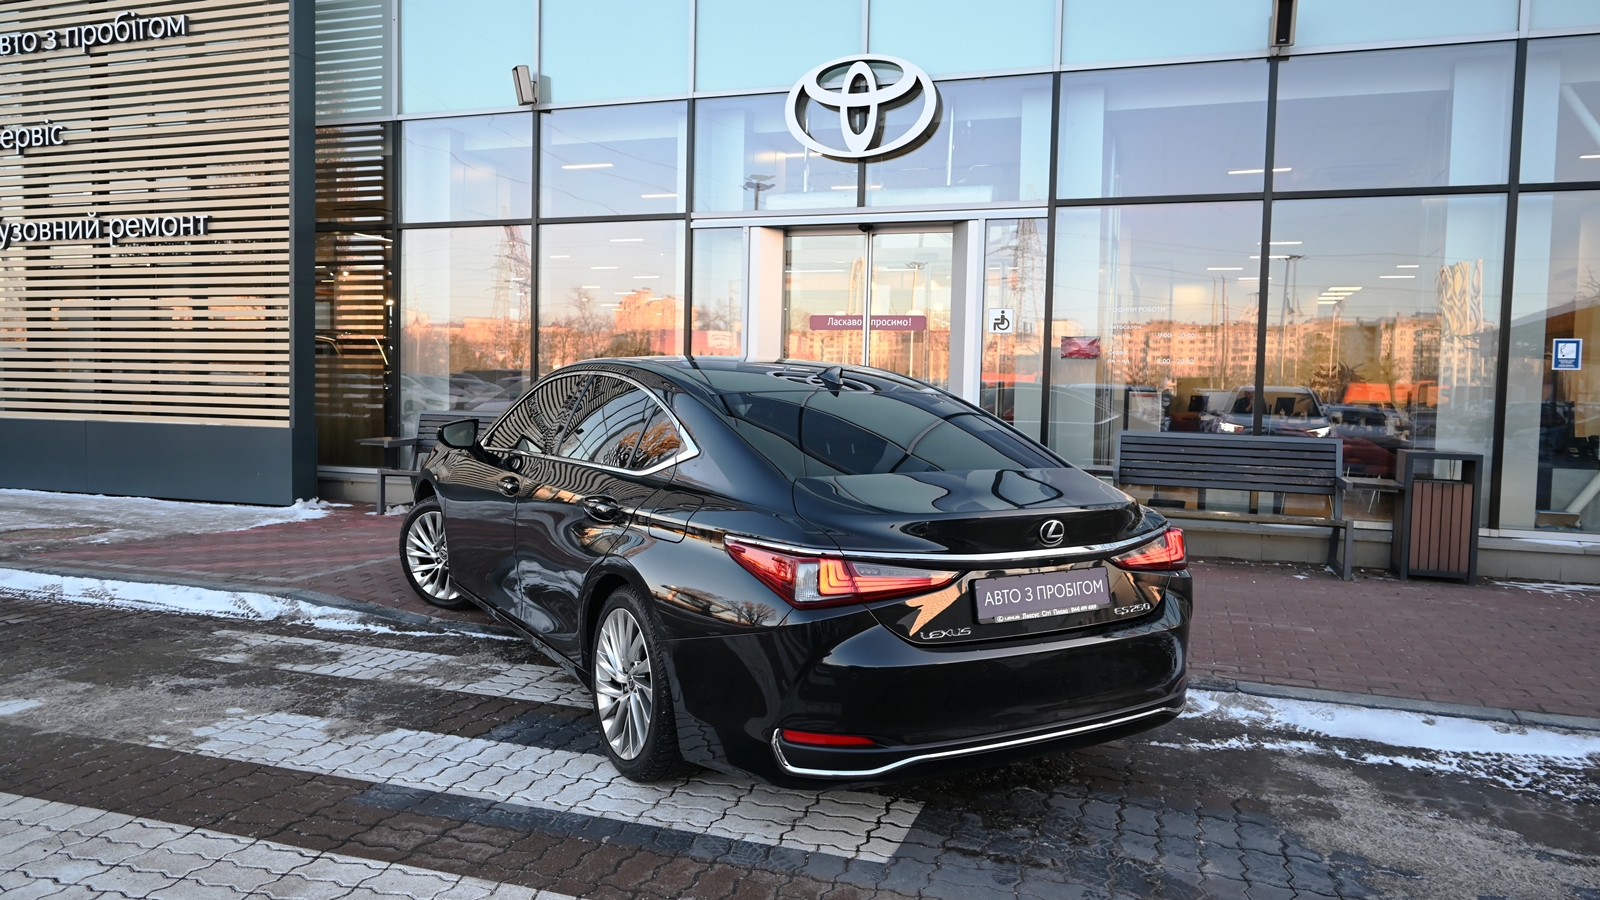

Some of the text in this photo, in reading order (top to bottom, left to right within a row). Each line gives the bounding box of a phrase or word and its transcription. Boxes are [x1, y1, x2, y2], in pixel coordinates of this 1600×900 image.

[45, 30, 57, 50] з
[66, 12, 186, 53] пробігом
[110, 215, 209, 247] ремонт
[827, 317, 912, 328] Ласкаво просимо!
[984, 588, 1021, 607] АВТО
[1036, 579, 1104, 601] ПРОБІГОМ
[919, 627, 972, 640] LEXUS
